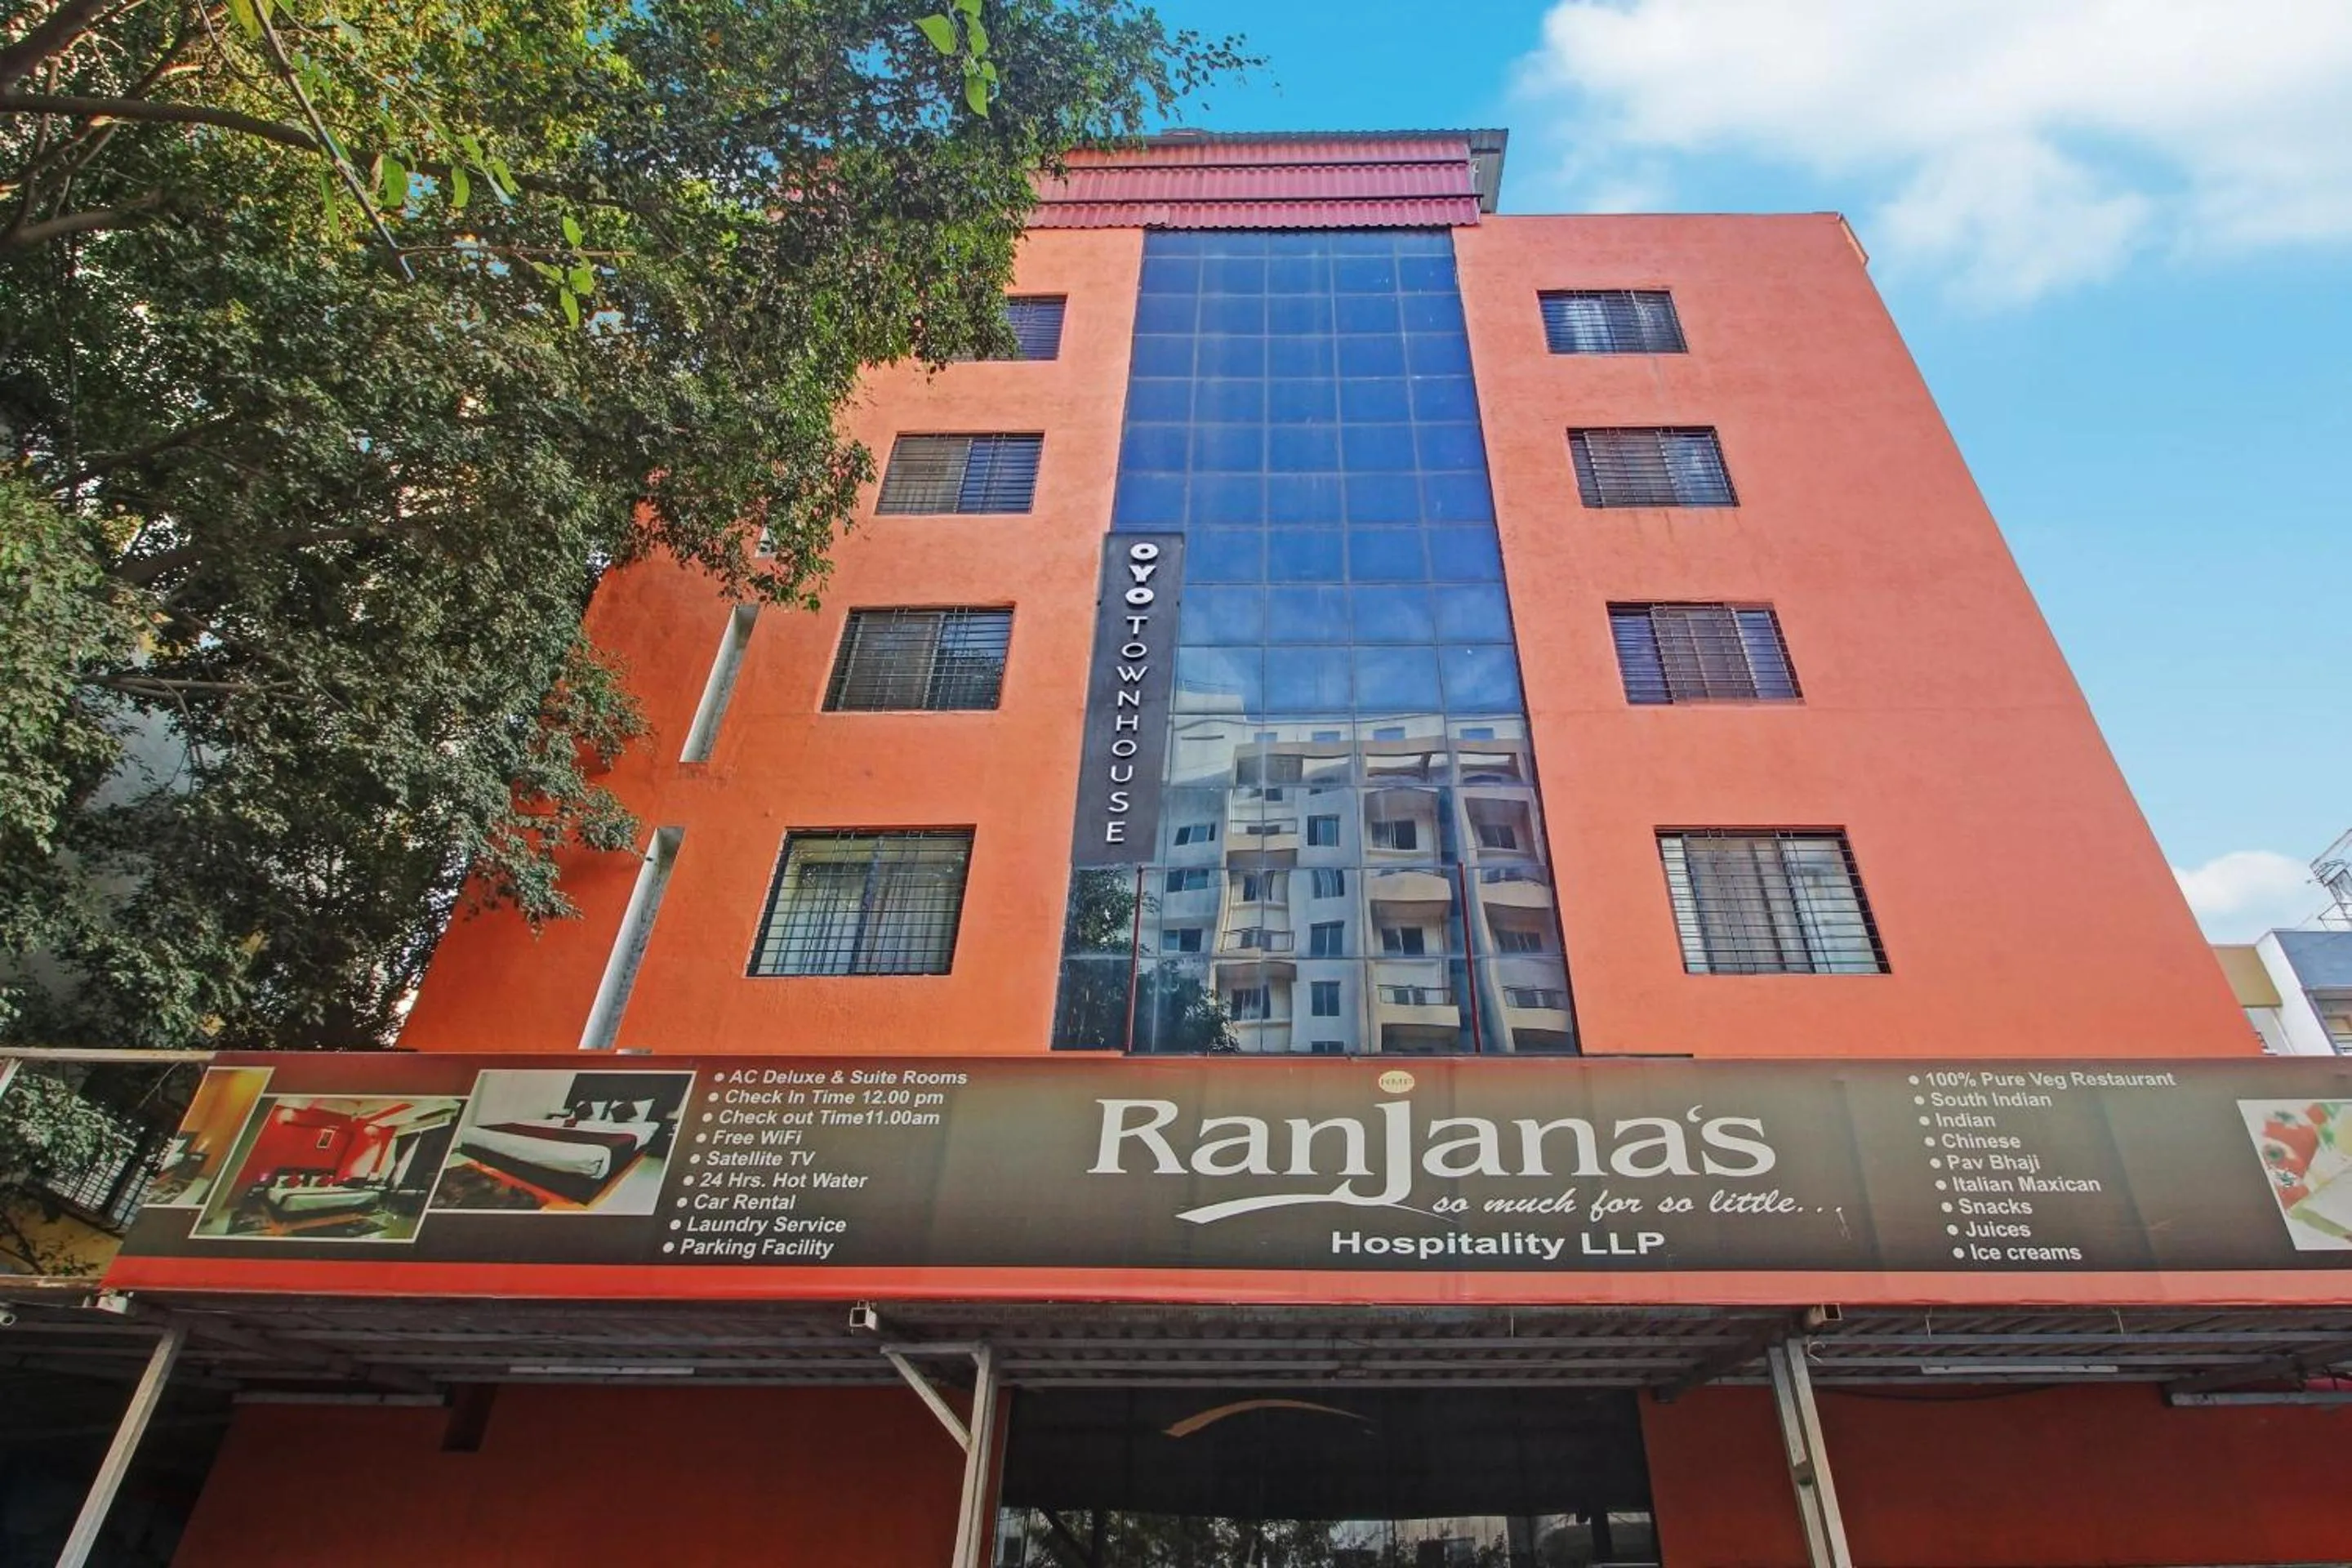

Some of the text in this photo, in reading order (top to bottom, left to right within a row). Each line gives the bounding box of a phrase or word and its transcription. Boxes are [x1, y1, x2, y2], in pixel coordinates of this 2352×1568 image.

[1105, 542, 1160, 843] OYO TOWNHOUSE
[728, 1069, 968, 1085] AC Deluxe & Suite Rooms
[1926, 1071, 2177, 1090] 100% Pure Veg Restaurant
[725, 1089, 944, 1107] Check In Time 12.00 pm
[1931, 1092, 2052, 1107] South Indian
[719, 1109, 778, 1125] Check
[782, 1110, 814, 1125] out
[1935, 1112, 1996, 1128] Indian
[712, 1129, 803, 1145] Free WiFi
[1941, 1133, 2021, 1149] Chinese
[706, 1150, 816, 1166] Satellite TV
[1085, 1098, 1776, 1206] Ranjana's
[1946, 1154, 2041, 1174] Pav Bhaji
[699, 1172, 869, 1188] 24 Hrs. Hot Water
[1952, 1176, 2101, 1192] Italian Maxican
[694, 1193, 796, 1210] Car Rental
[1432, 1196, 1470, 1215] so
[1483, 1187, 1576, 1216] much
[1588, 1187, 1642, 1224] for
[1656, 1196, 1695, 1215] so
[1958, 1197, 2033, 1214] Snacks
[687, 1216, 847, 1236] Laundry Service
[1966, 1220, 2032, 1237] Juices
[679, 1238, 835, 1260] Parking Facility
[1331, 1229, 1665, 1261] Hospitality LLP
[1970, 1243, 2082, 1260] Ice creams
